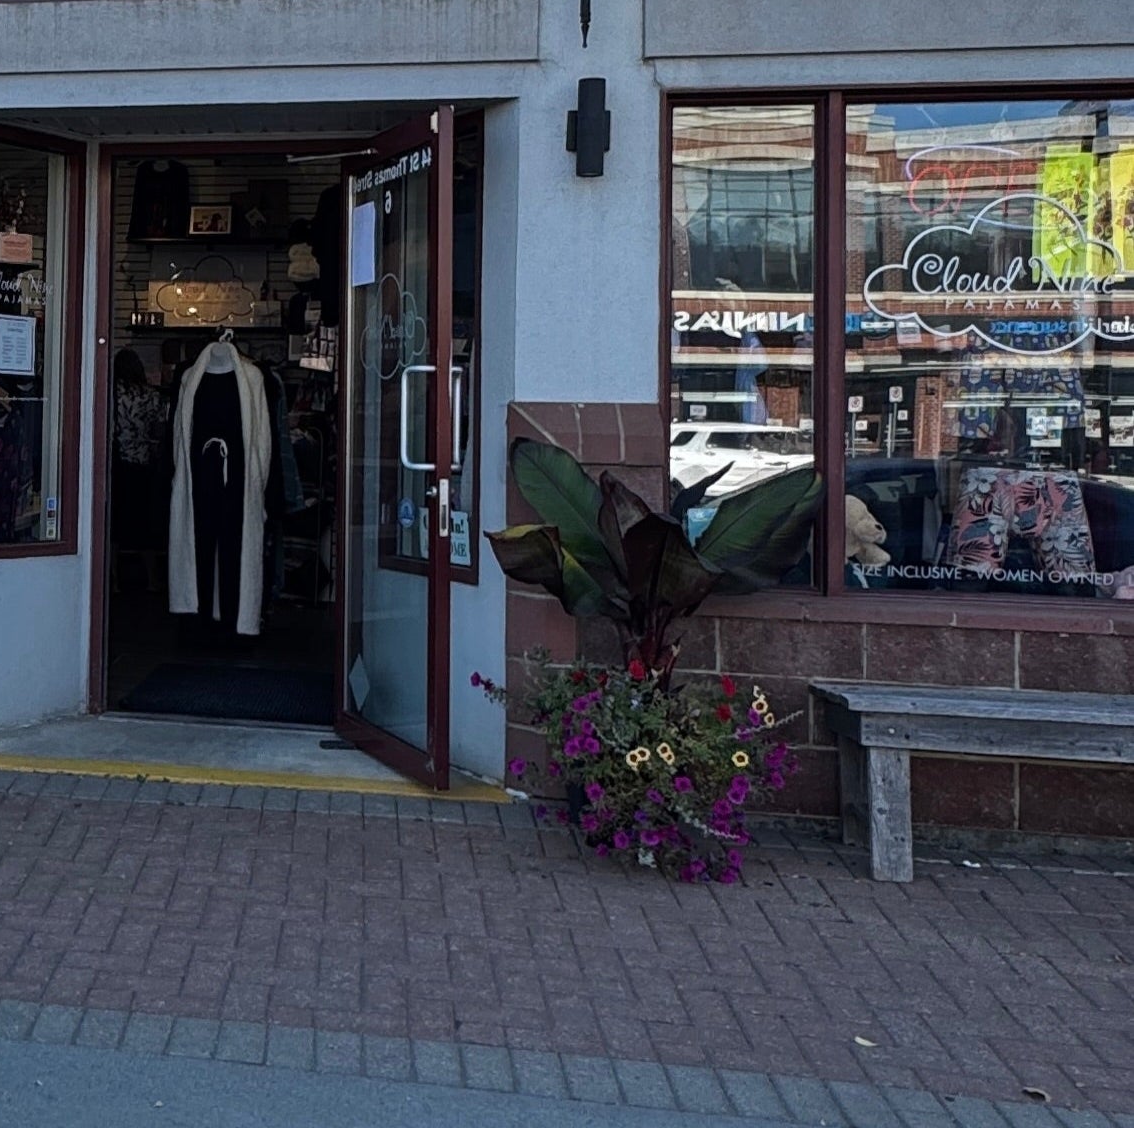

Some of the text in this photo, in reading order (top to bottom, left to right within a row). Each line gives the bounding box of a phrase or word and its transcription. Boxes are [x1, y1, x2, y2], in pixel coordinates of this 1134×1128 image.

[27, 273, 54, 296] Nine
[912, 254, 1116, 294] Cloud Nine
[944, 298, 1083, 311] PAJAMAS
[853, 563, 882, 577] SIZE
[886, 565, 963, 580] INCLUSIVE
[976, 567, 1044, 583] WOMEN
[1048, 570, 1114, 586] OWNED
